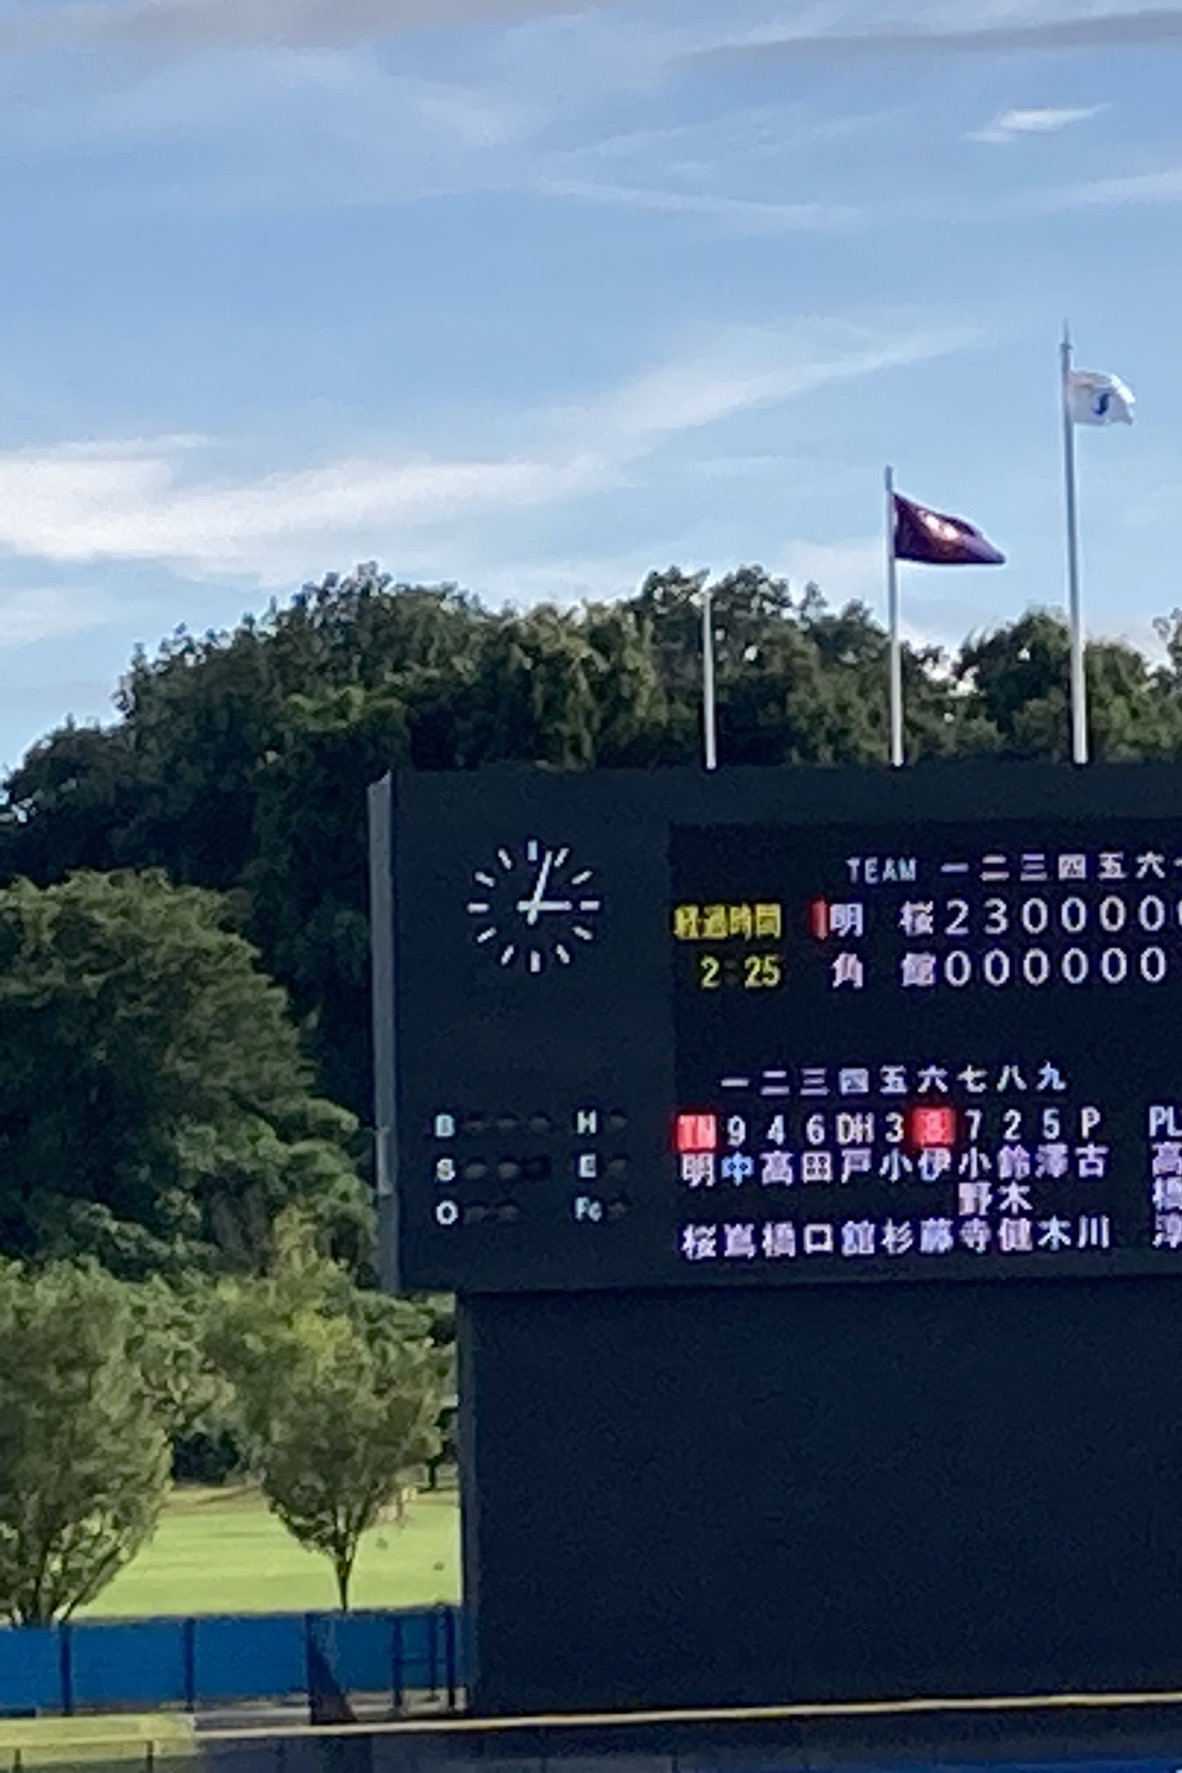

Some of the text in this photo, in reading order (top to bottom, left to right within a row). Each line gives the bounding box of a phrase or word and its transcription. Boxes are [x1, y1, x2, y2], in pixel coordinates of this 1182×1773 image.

[847, 858, 916, 884] TEAM
[980, 856, 1009, 881] 二
[1021, 854, 1047, 880] 三
[1059, 854, 1086, 879] 四
[1099, 853, 1126, 879] 五
[1137, 852, 1165, 878] 六
[945, 900, 968, 935] 2
[985, 899, 1007, 934] 3
[1023, 898, 1047, 934] 0
[1062, 897, 1087, 932] 0
[1100, 896, 1125, 931] 0
[1139, 895, 1165, 931] 0
[945, 951, 971, 986] 0
[984, 948, 1009, 986] 0
[1023, 948, 1049, 985] 0
[1062, 948, 1088, 983] 0
[1101, 948, 1127, 983] 0
[1141, 947, 1165, 982] 0
[762, 1071, 789, 1095] 二
[801, 1069, 829, 1095] 三
[839, 1068, 869, 1095] 四
[880, 1065, 907, 1094] 五
[918, 1065, 948, 1092] 六
[958, 1065, 986, 1092] 七
[997, 1065, 1027, 1091] 八
[1037, 1062, 1066, 1090] 九
[436, 1115, 454, 1137] B
[578, 1111, 596, 1133] H
[728, 1115, 745, 1147] 9
[767, 1115, 785, 1145] 4
[807, 1114, 825, 1145] 6
[836, 1112, 874, 1144] DH
[886, 1112, 904, 1142] 3
[965, 1110, 982, 1140] 7
[1004, 1109, 1021, 1141] 2
[1043, 1108, 1059, 1139] 5
[1082, 1107, 1100, 1138] P
[437, 1159, 455, 1181] S
[579, 1154, 596, 1177] E
[437, 1201, 458, 1224] O
[681, 1152, 716, 1259] 明桜
[801, 1152, 833, 1254] 田口
[879, 1148, 913, 1254] 小杉
[959, 1147, 993, 1253] 小野寺
[1075, 1143, 1109, 1248] 古川
